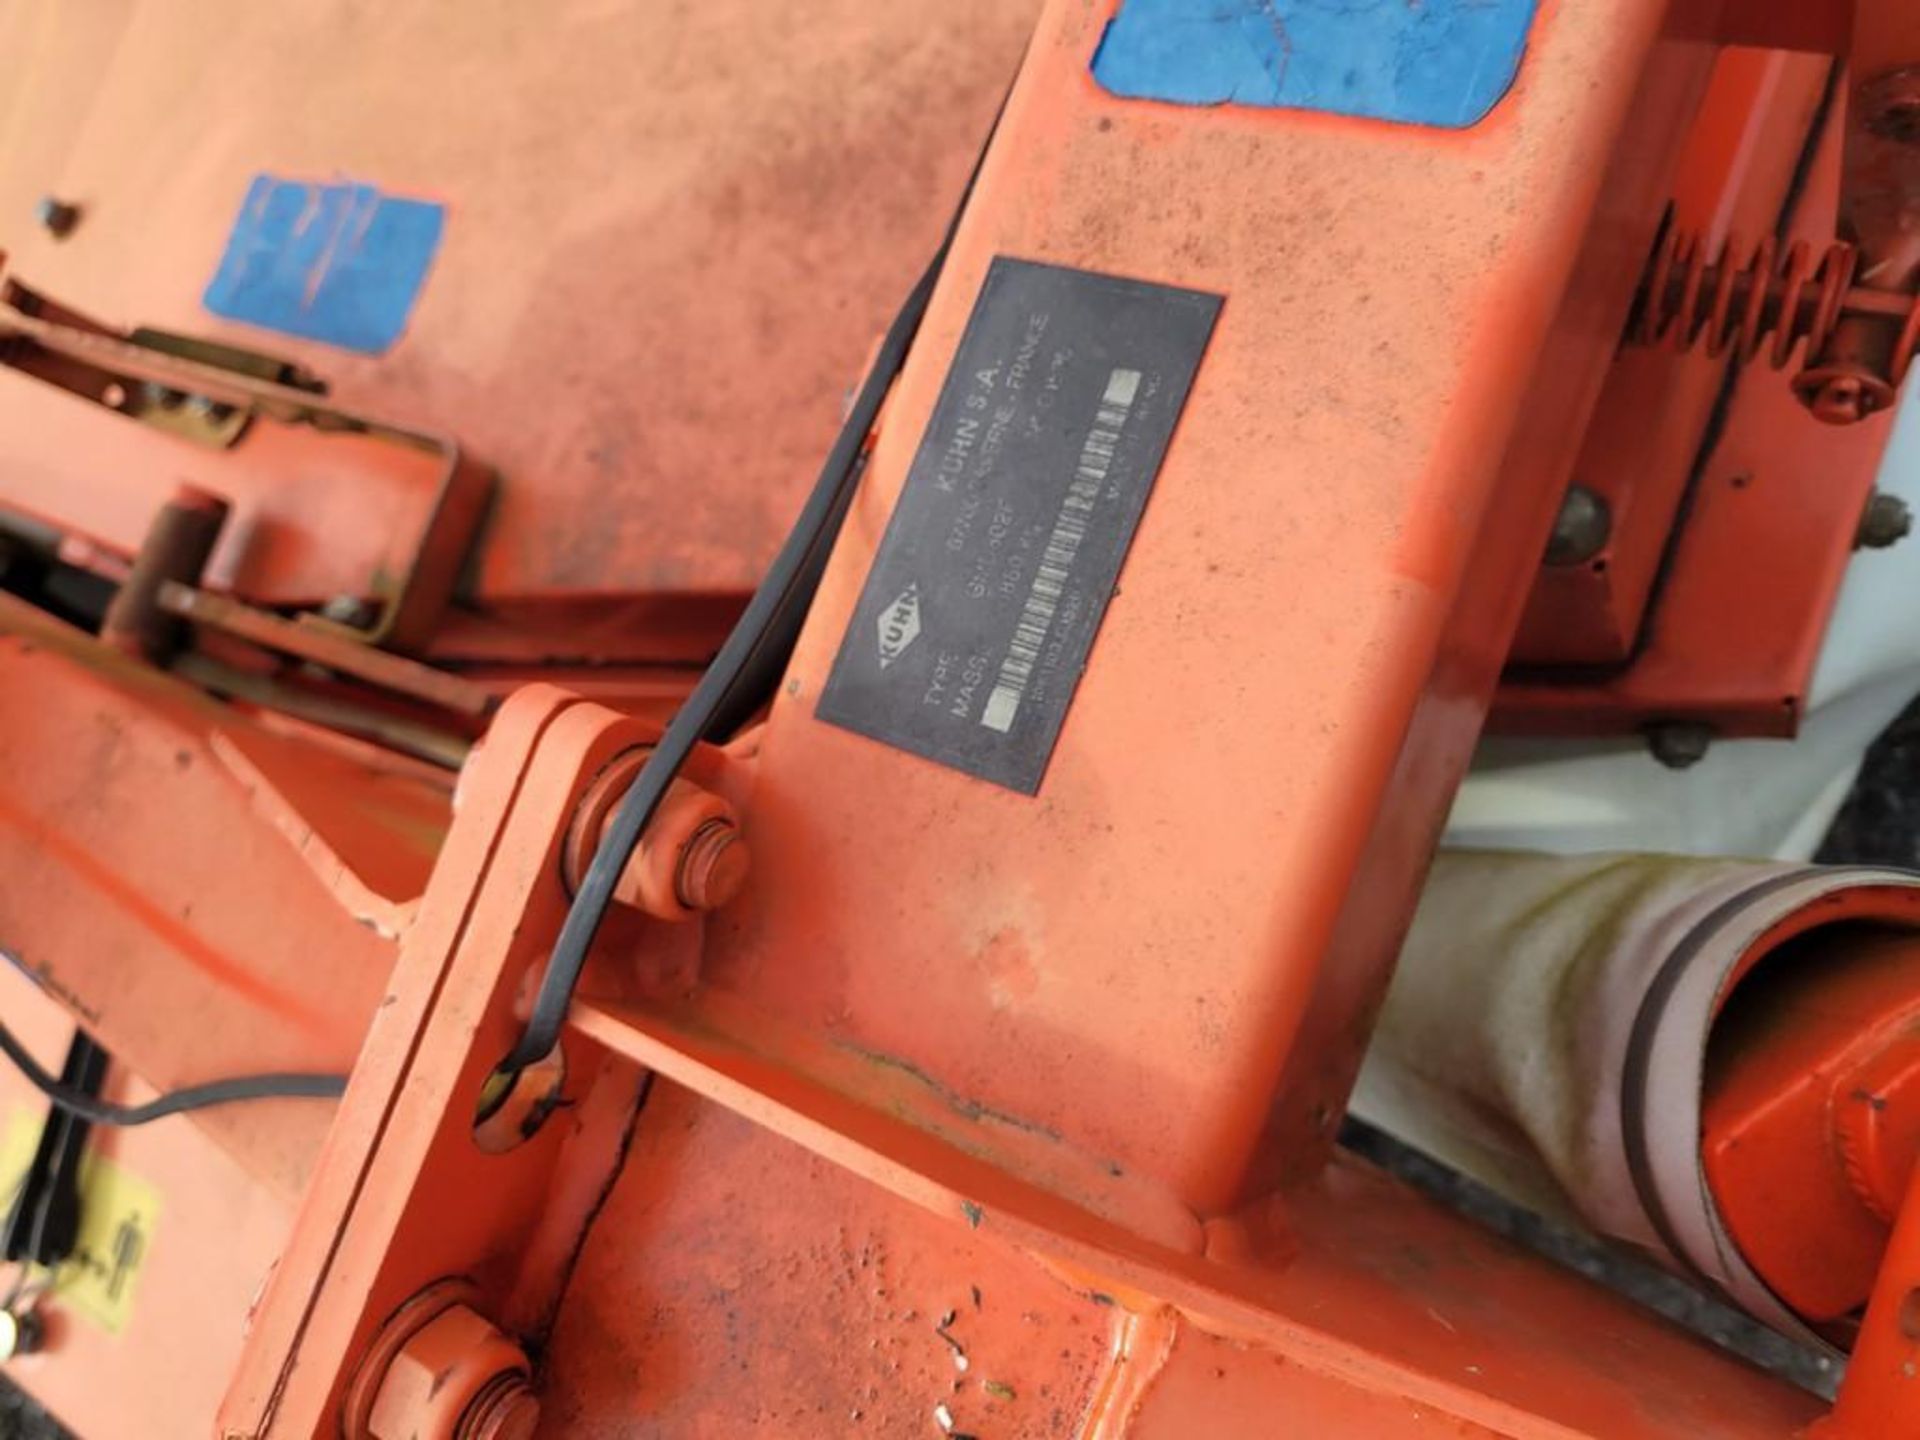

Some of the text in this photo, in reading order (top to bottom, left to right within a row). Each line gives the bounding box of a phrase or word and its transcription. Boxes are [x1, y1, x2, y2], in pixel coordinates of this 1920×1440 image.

[937, 417, 980, 493] KUHN
[879, 591, 918, 659] KUHN
[950, 645, 993, 718] MASS
